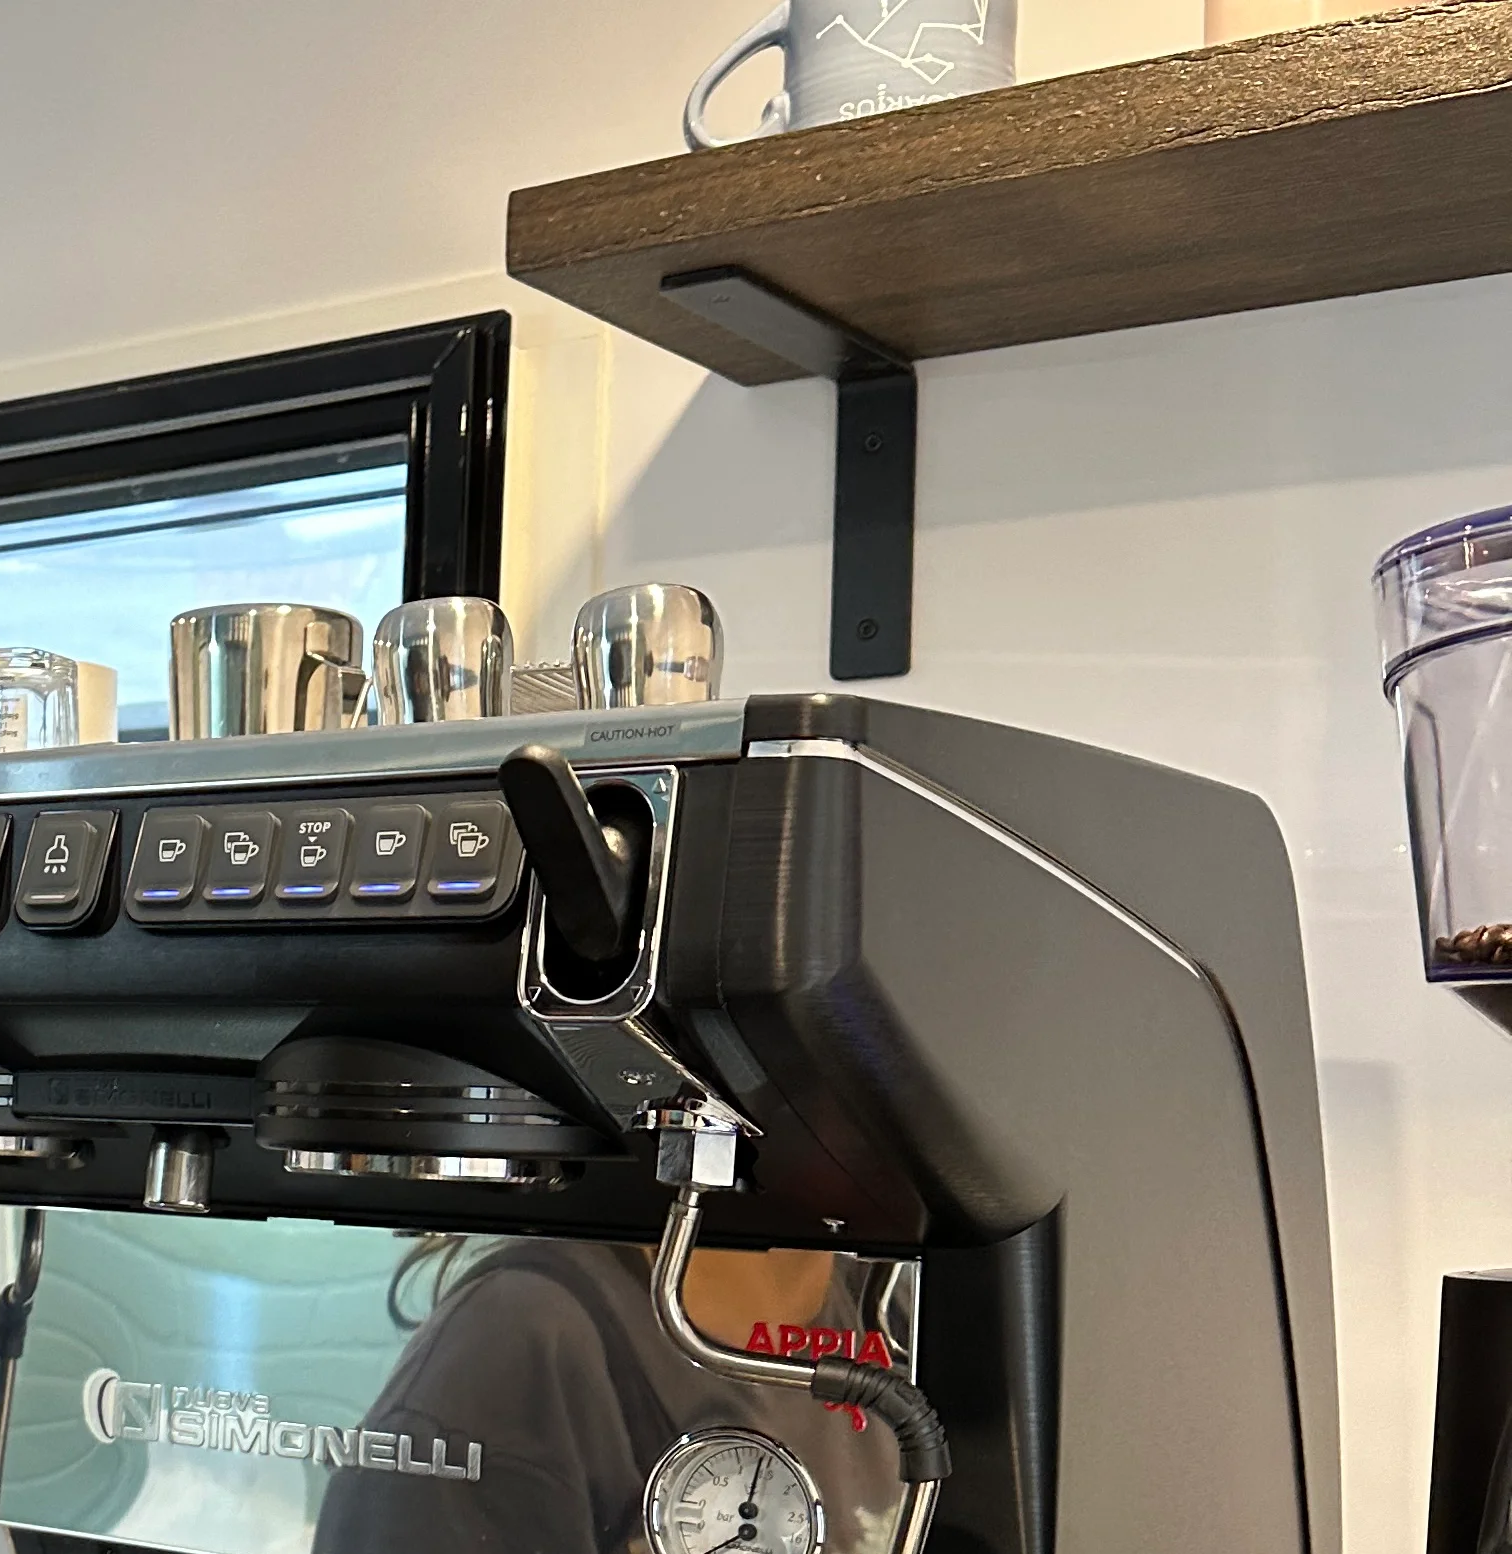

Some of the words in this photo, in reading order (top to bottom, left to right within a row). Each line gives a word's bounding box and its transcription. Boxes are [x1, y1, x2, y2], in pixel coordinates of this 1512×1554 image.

[590, 725, 674, 742] CAUTION-HOT
[298, 821, 331, 836] STOP
[745, 1321, 893, 1369] APPIA
[171, 1385, 271, 1414] nuova
[170, 1410, 483, 1482] SIMONELLI
[712, 1476, 729, 1487] 0.5
[716, 1510, 735, 1522] bar
[787, 1511, 804, 1523] 2.5
